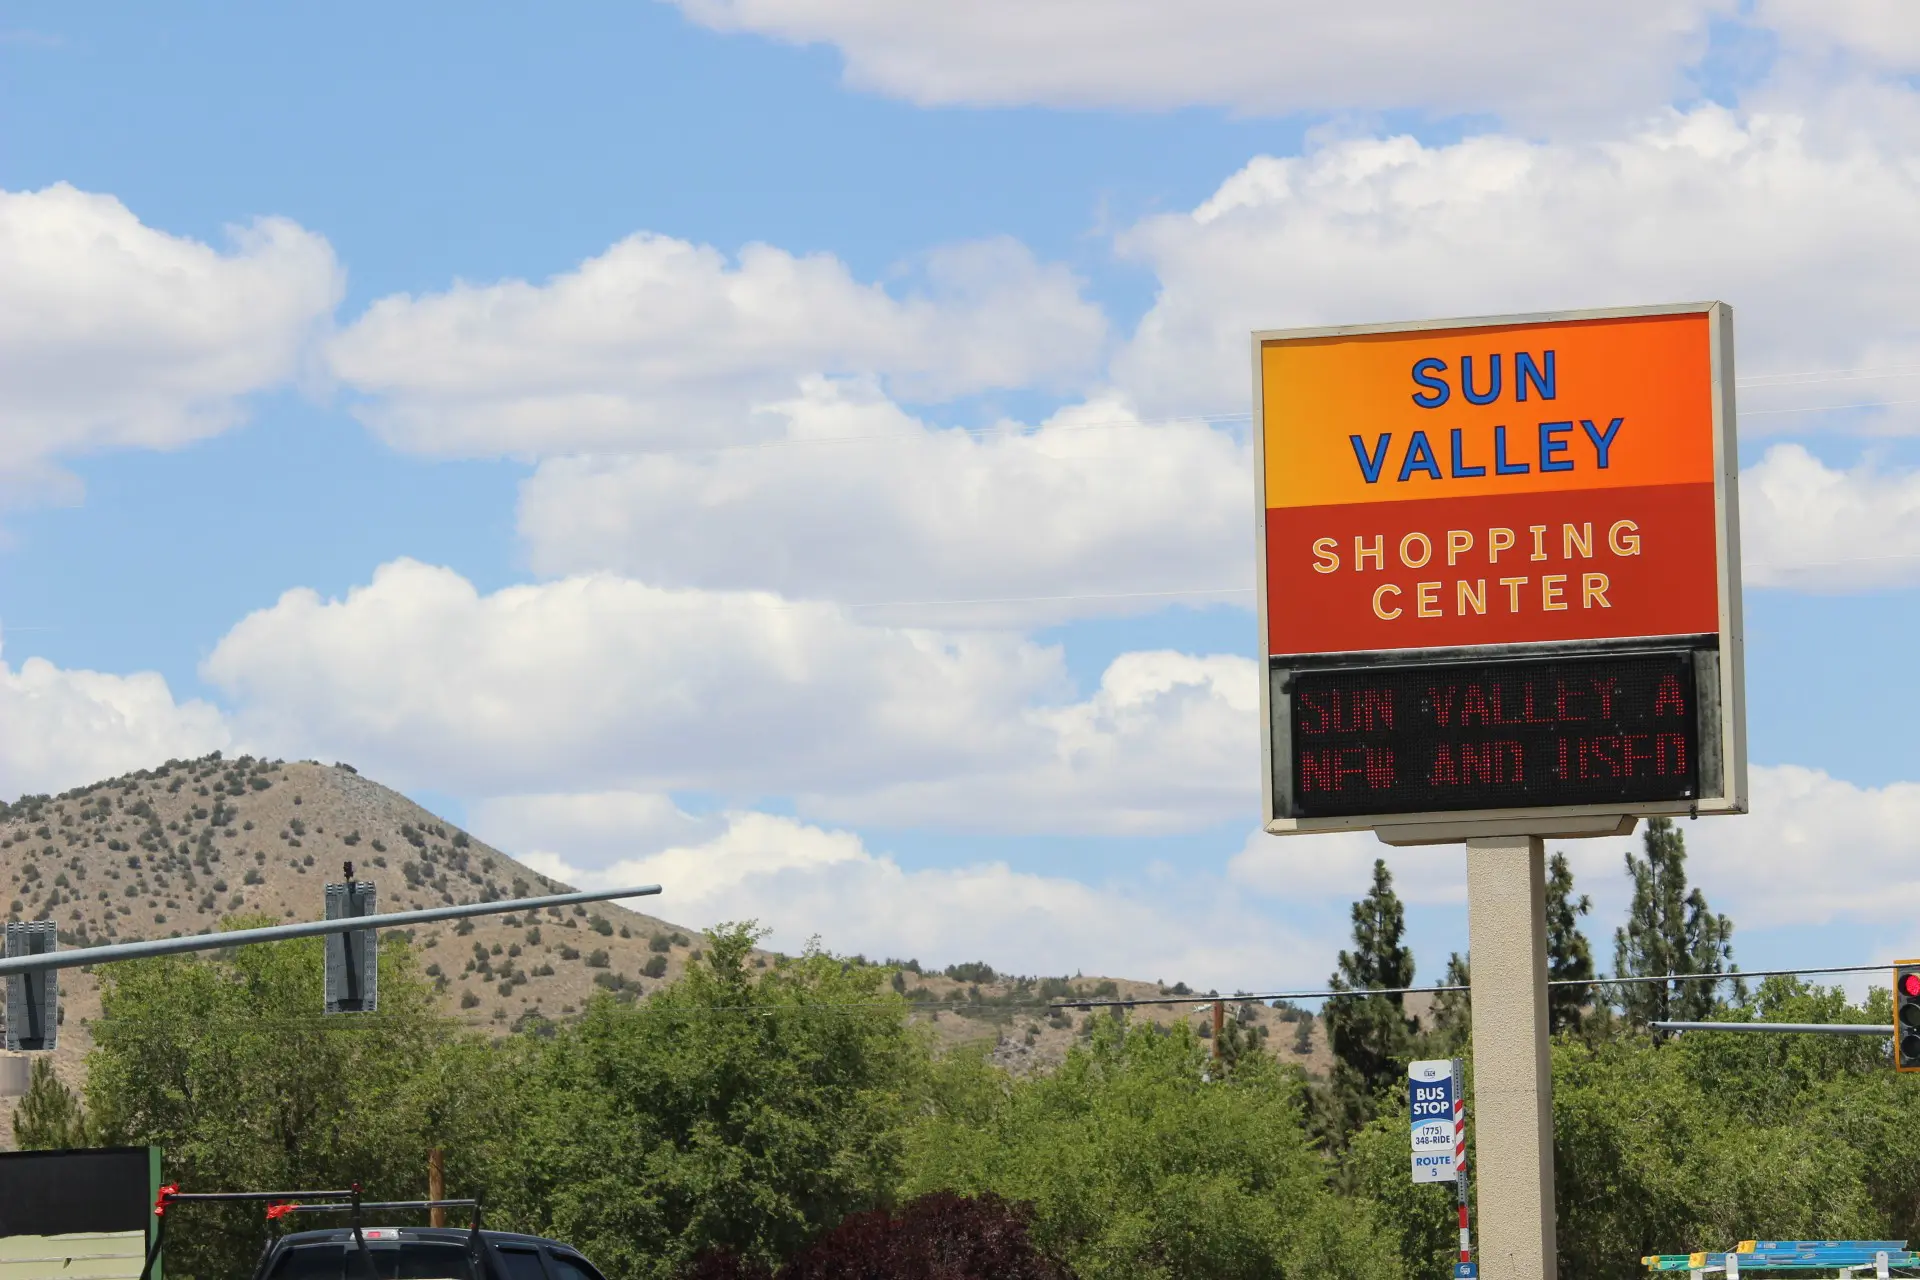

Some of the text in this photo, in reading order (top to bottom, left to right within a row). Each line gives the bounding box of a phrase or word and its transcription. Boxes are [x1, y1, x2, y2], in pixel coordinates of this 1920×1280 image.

[1412, 350, 1556, 409] SUN
[1350, 418, 1624, 483] VALLEY
[1312, 520, 1641, 573] SHOPPING
[1373, 573, 1612, 620] CENTER
[1301, 674, 1685, 733] SUN VALLEY A
[1430, 740, 1524, 785] AND
[1413, 1102, 1450, 1115] STOP
[1416, 1087, 1445, 1101] BUS
[1415, 1135, 1451, 1145] 348-RIDE
[1422, 1125, 1442, 1136] (775)
[1416, 1156, 1451, 1166] ROUTE
[1431, 1168, 1438, 1177] 5
